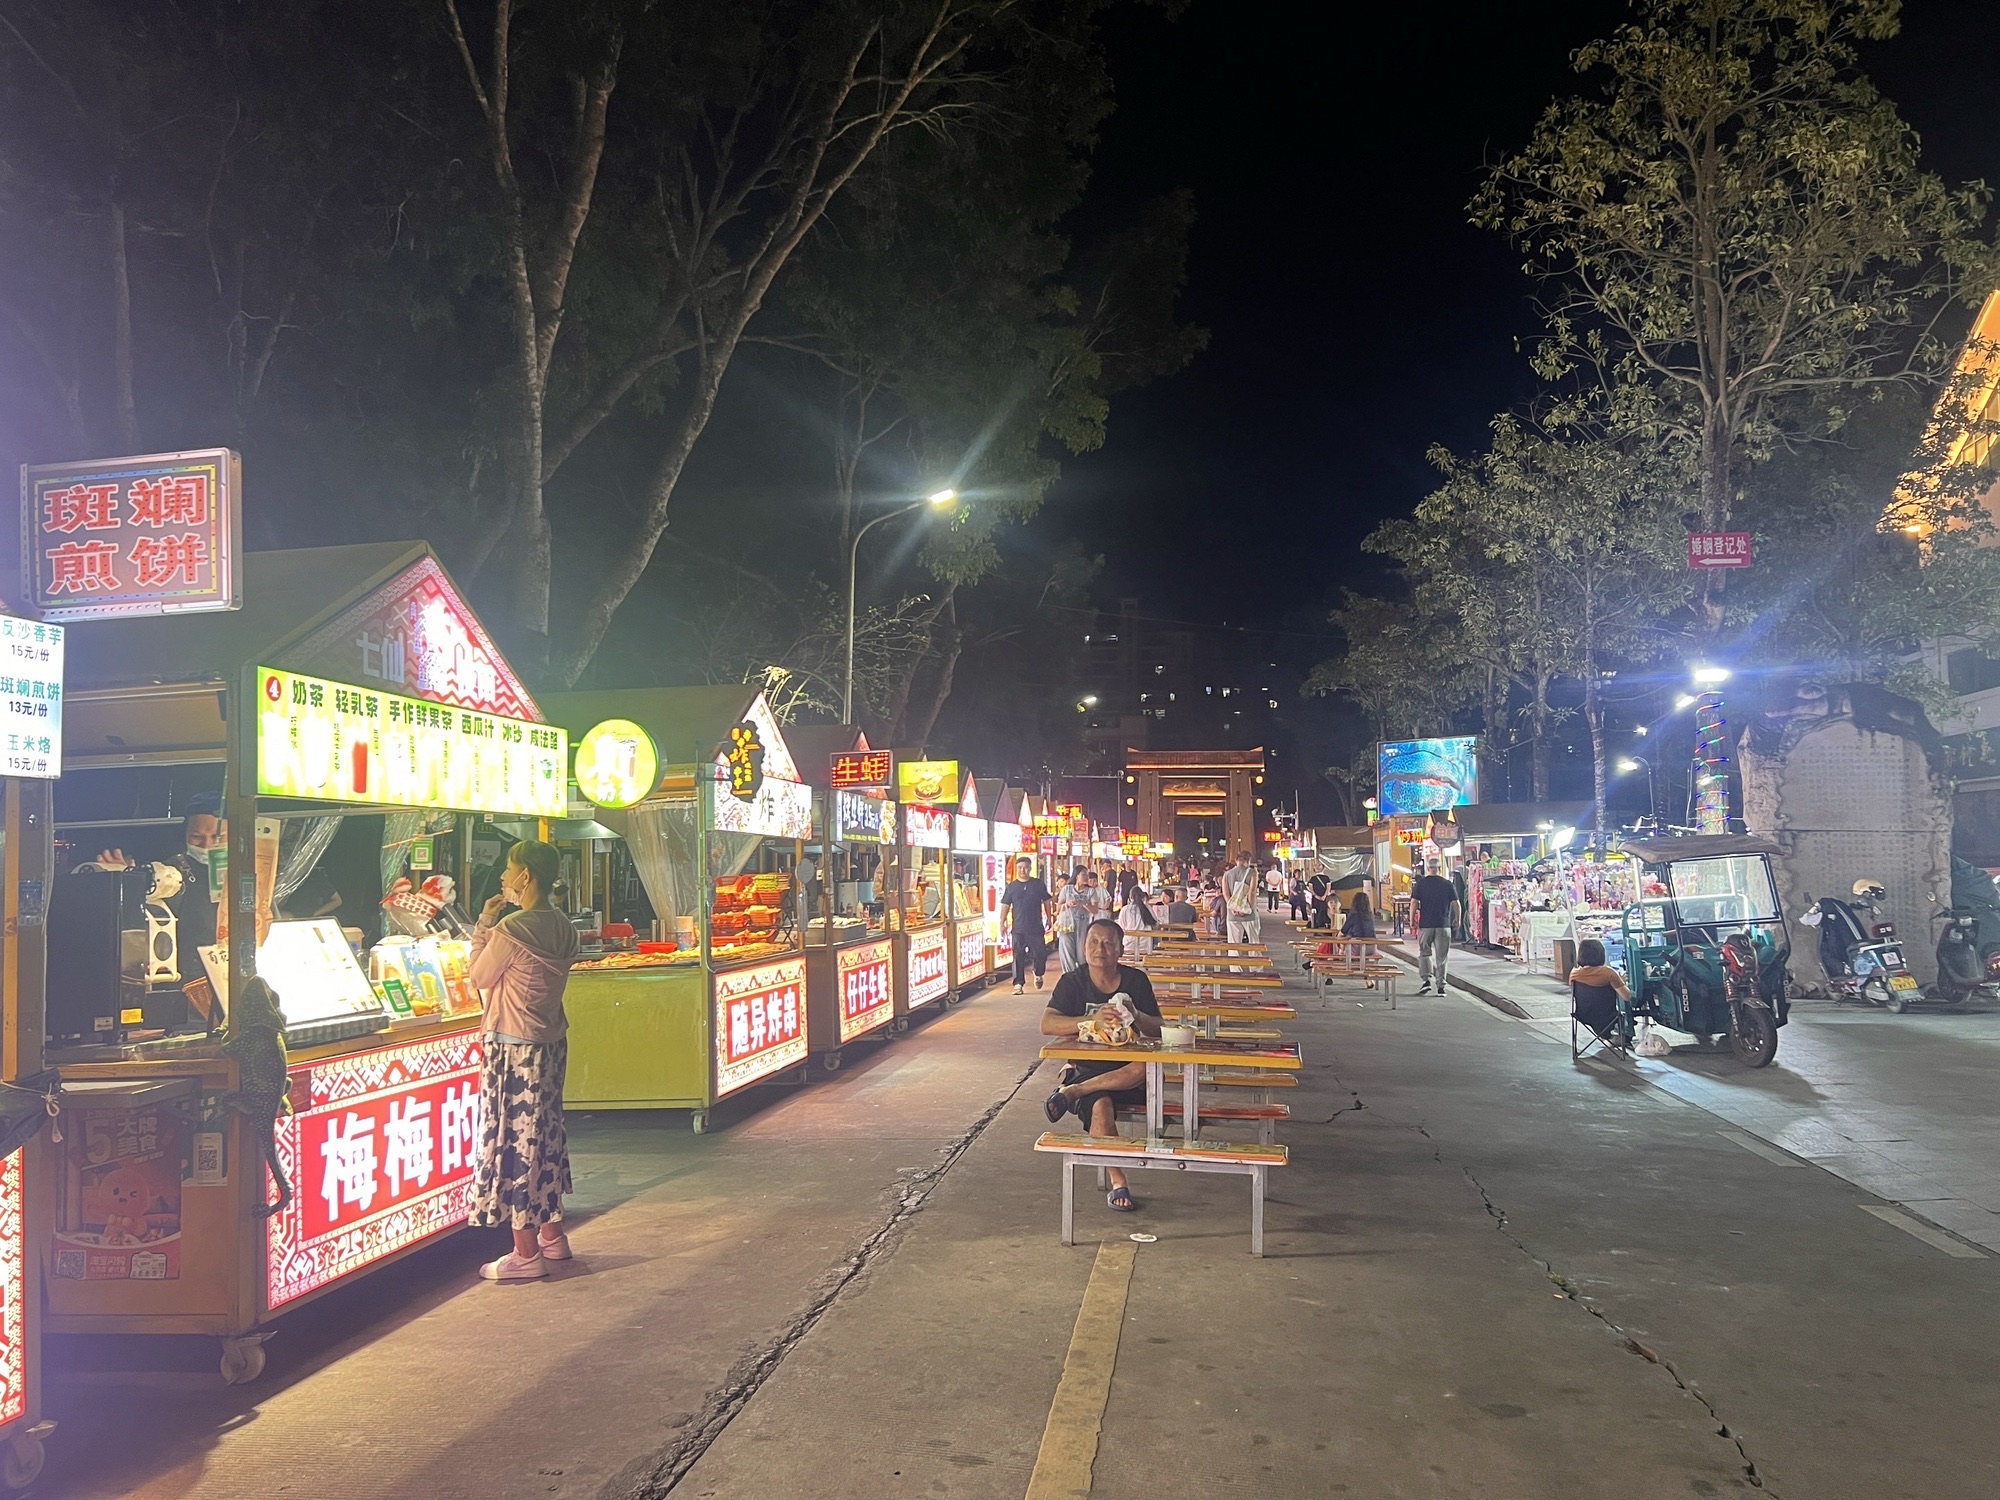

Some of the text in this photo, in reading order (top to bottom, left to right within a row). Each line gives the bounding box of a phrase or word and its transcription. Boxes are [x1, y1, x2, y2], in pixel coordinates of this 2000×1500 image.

[42, 475, 207, 533] 斑斓
[1691, 536, 1747, 556] 婚姻登记处
[46, 533, 208, 595] 煎饼
[2, 619, 62, 646] 反沙香芋
[11, 644, 50, 662] 15元/份
[0, 676, 61, 702] 斑斓煎饼
[268, 679, 280, 698] 4
[9, 701, 48, 718] 13元/份
[292, 679, 324, 708] 奶茶
[335, 689, 379, 718] 轻乳茶
[388, 700, 453, 731] 手作鲜果茶
[461, 713, 495, 739] 西瓜汁
[502, 723, 523, 744] 冰沙
[7, 734, 51, 754] 玉米烙
[8, 757, 47, 773] 15元/份
[834, 755, 887, 781] 生蚝
[321, 1080, 479, 1222] 梅梅的
